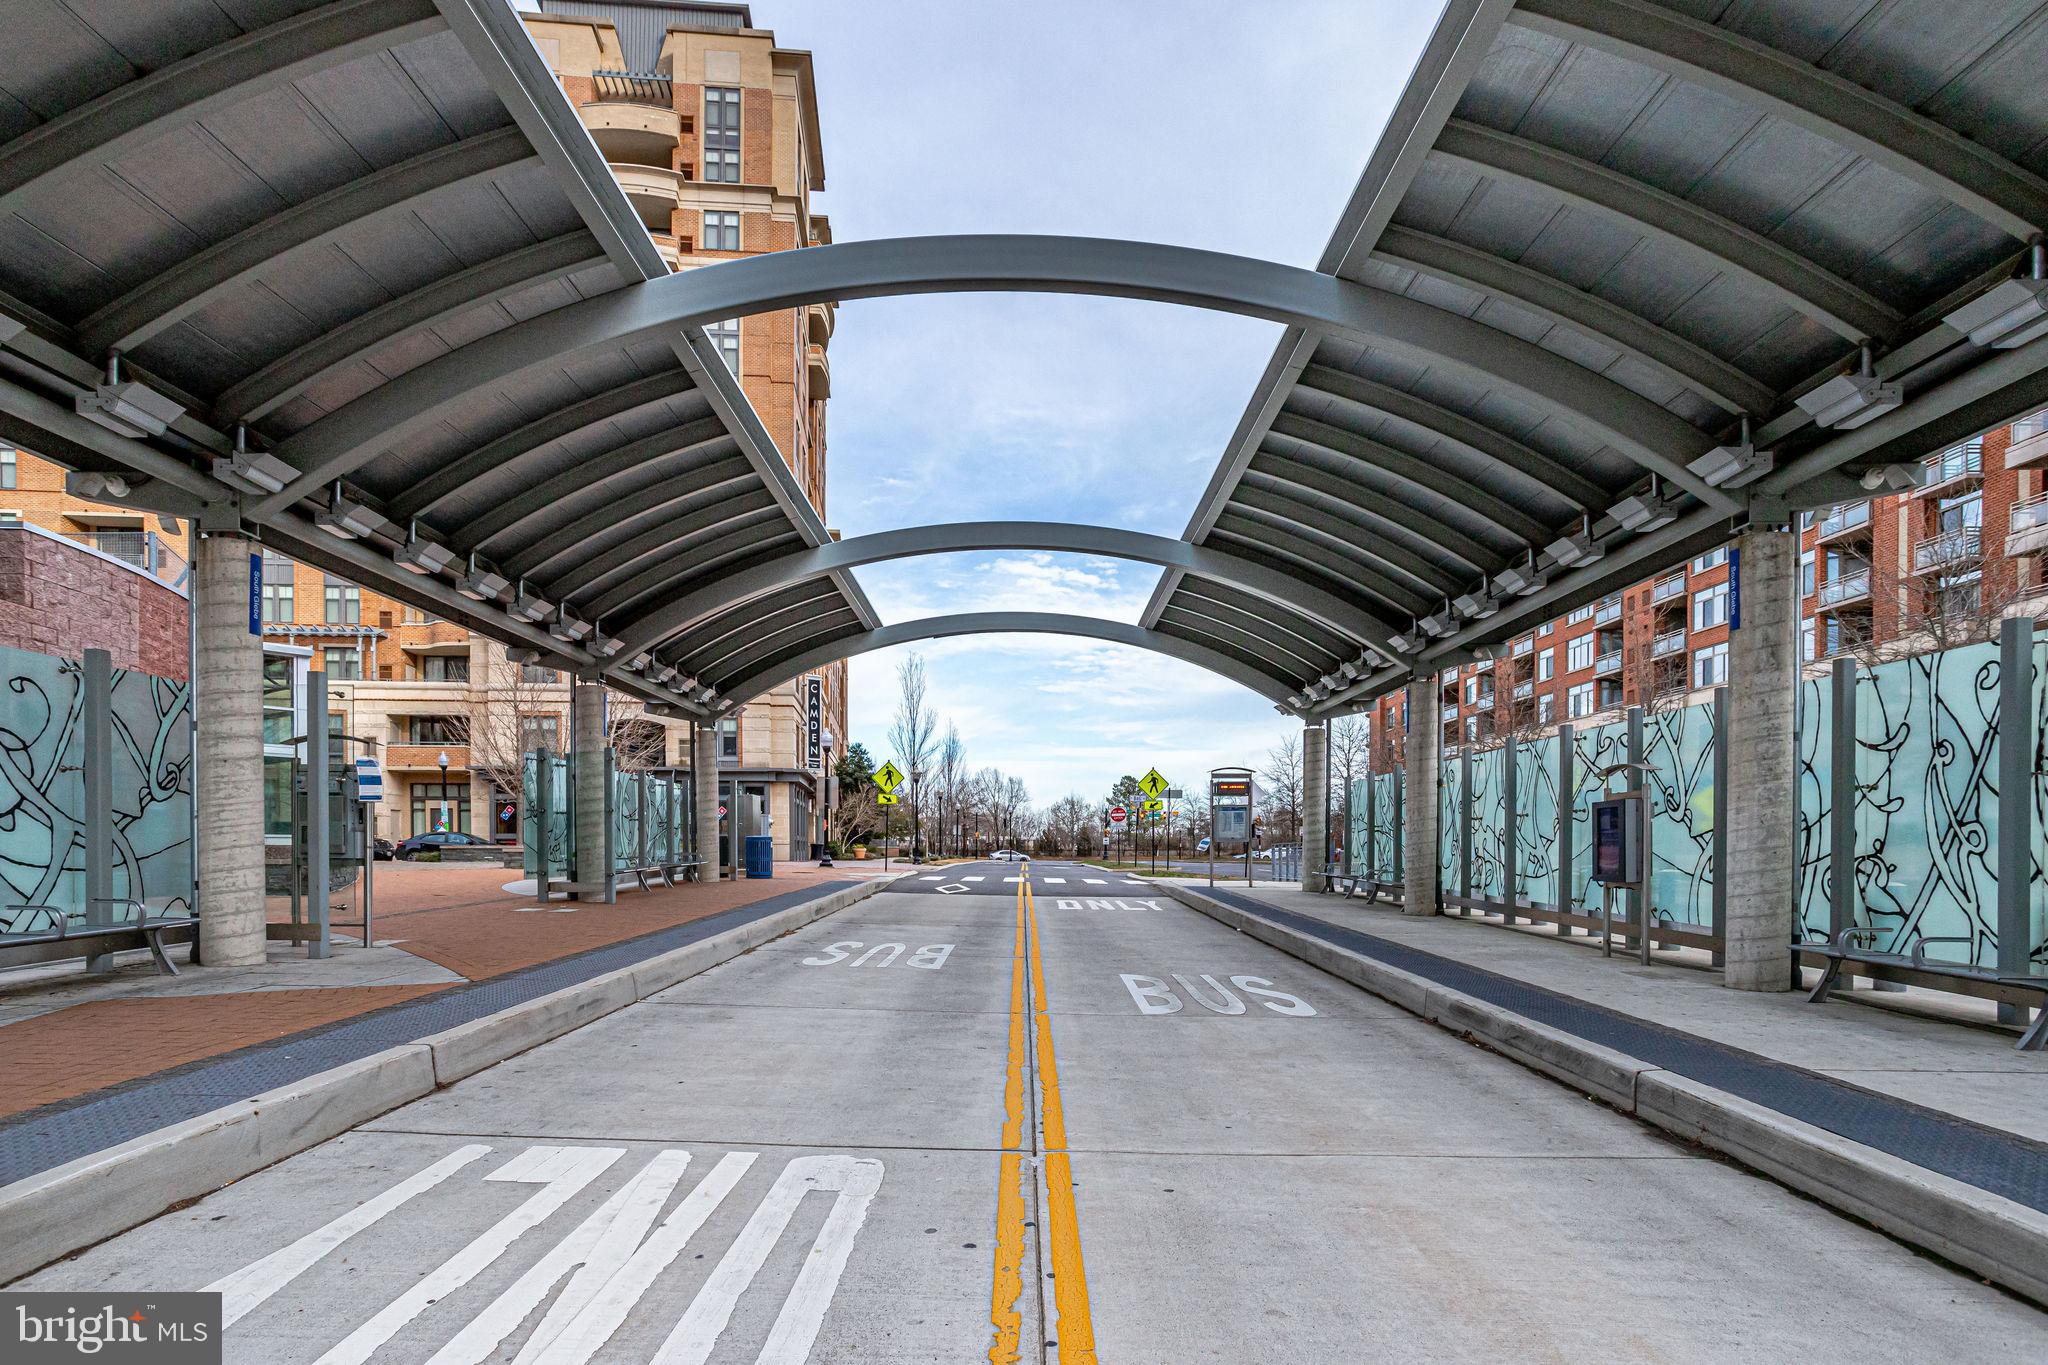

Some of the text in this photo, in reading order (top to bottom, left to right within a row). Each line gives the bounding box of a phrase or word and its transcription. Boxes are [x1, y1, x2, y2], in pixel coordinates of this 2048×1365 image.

[809, 683, 819, 755] CAMDEN
[1057, 899, 1163, 911] ONLY
[801, 941, 956, 970] BUS
[1119, 973, 1318, 1016] BUS
